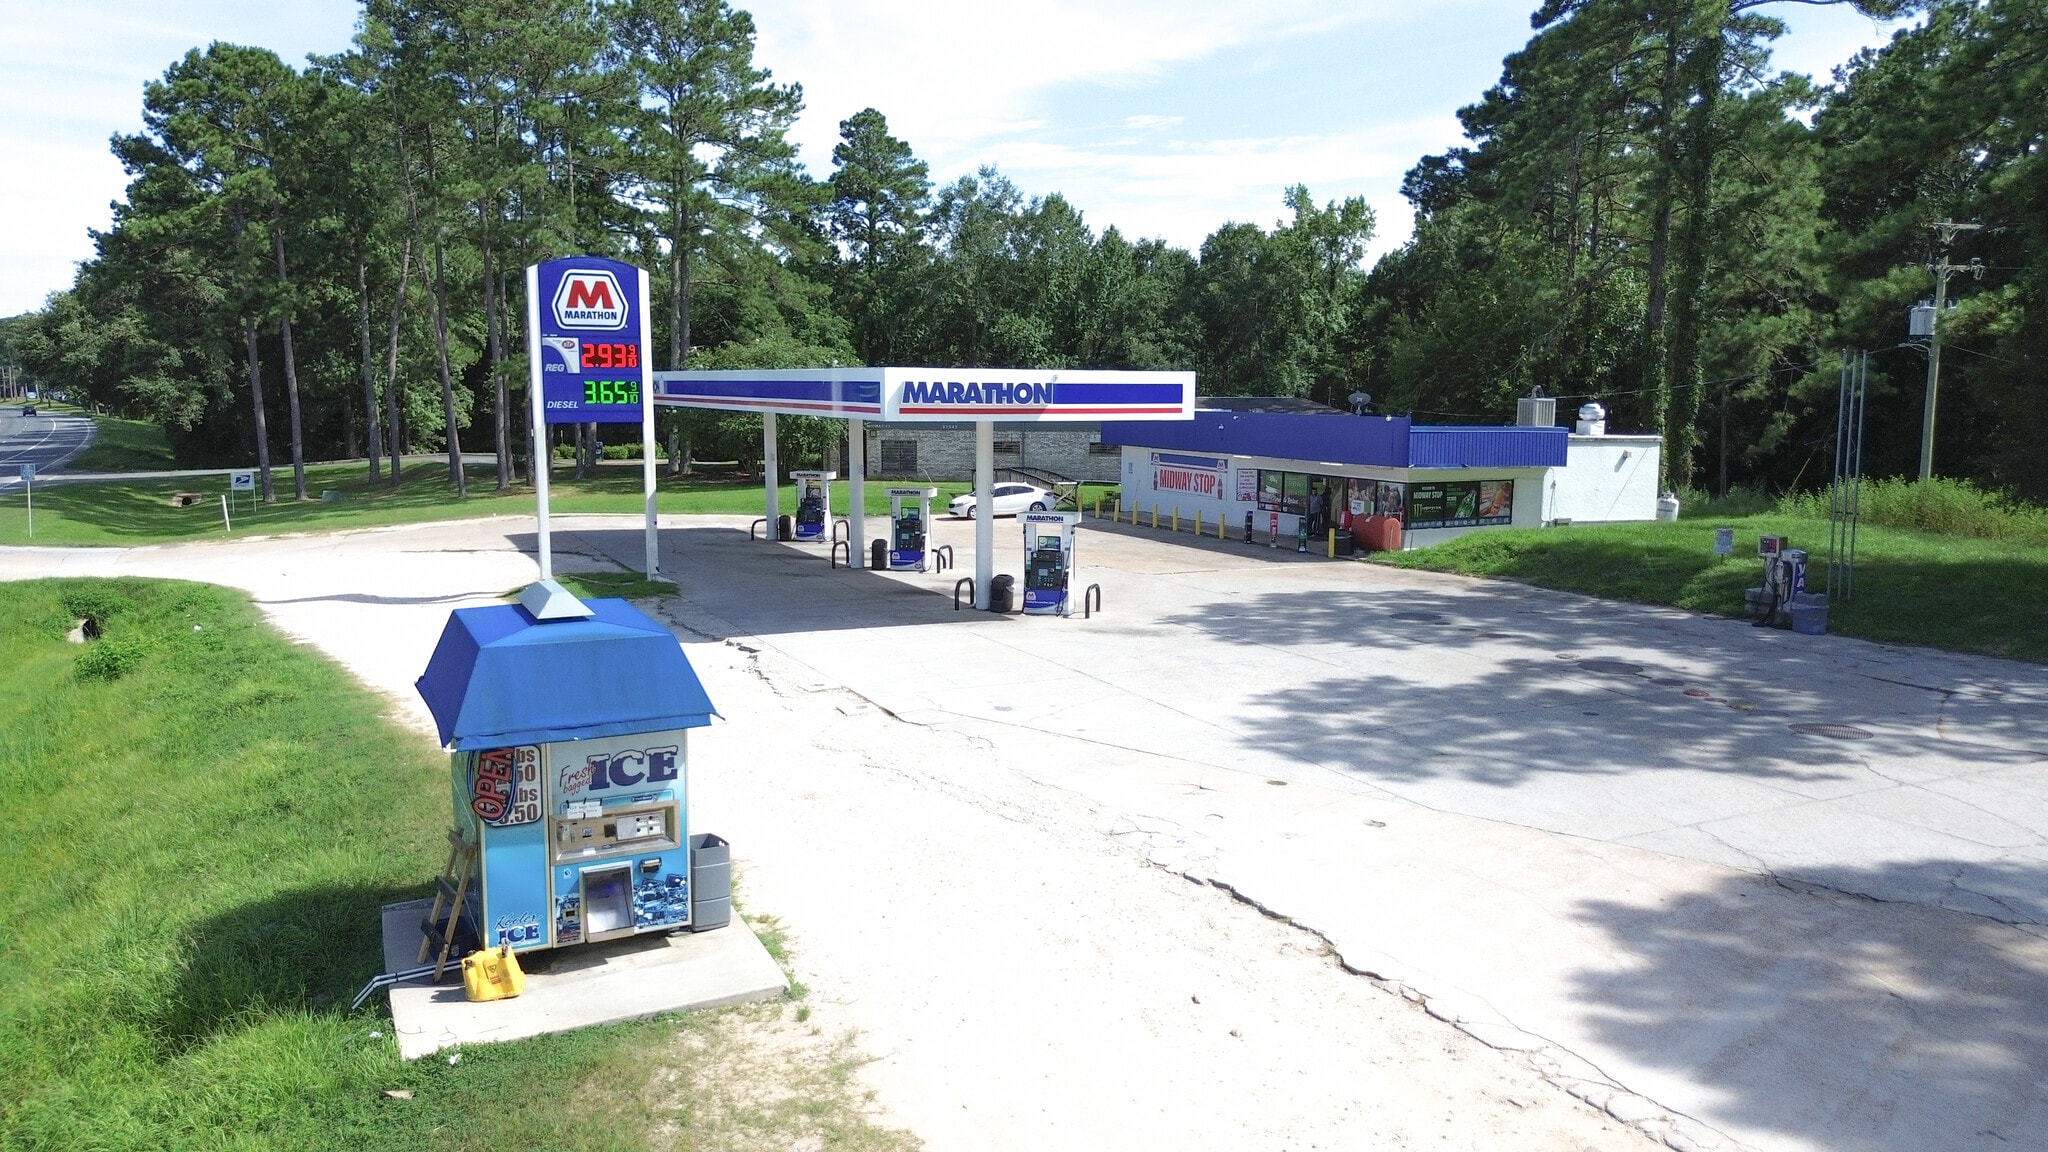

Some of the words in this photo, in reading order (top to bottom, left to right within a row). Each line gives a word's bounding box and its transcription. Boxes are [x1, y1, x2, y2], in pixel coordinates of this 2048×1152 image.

[566, 280, 615, 309] M
[564, 310, 617, 320] MARATHON
[581, 343, 626, 368] 2.93
[545, 363, 565, 372] REG
[583, 381, 628, 404] 3.65
[902, 381, 1052, 404] MARATHON
[547, 401, 579, 409] DIESEL
[1159, 469, 1193, 491] MIDWAY
[1193, 473, 1216, 495] STOP
[559, 758, 596, 787] Fresh
[587, 745, 678, 791] ICE
[473, 747, 514, 819] OPEN
[563, 777, 592, 796] bagged
[498, 923, 540, 944] ICE
